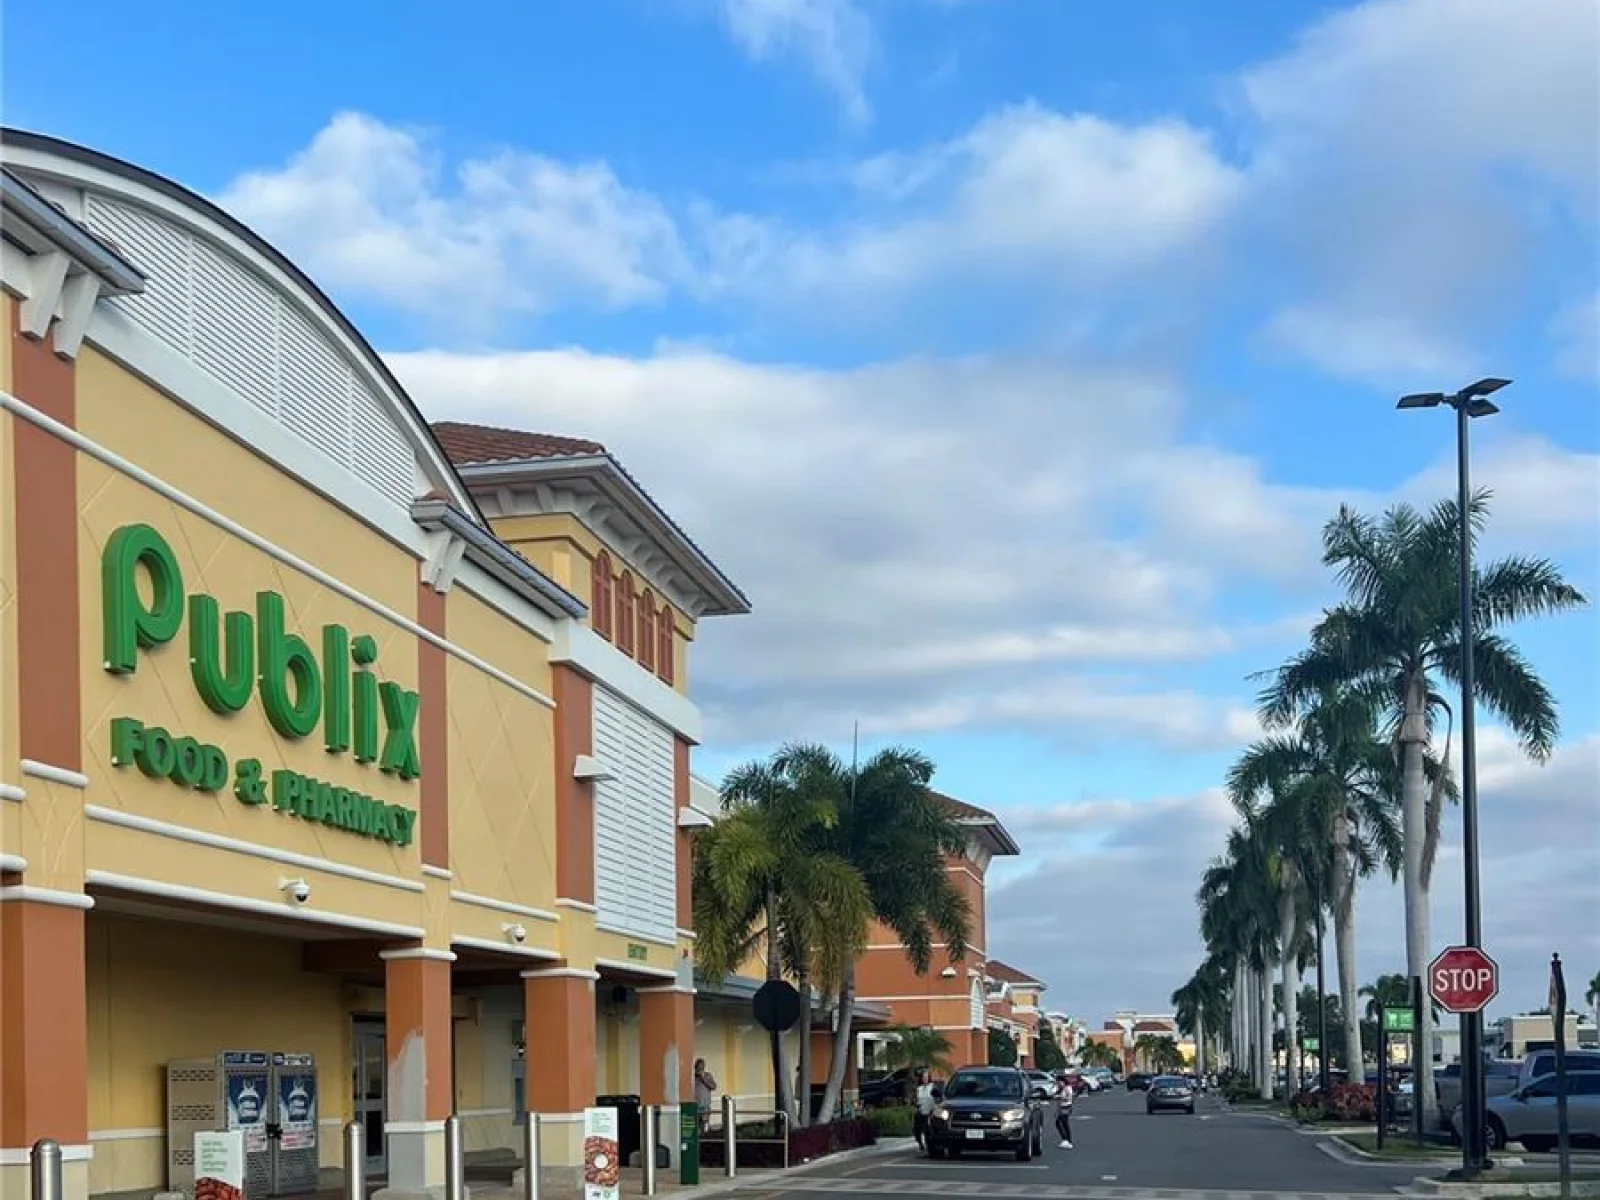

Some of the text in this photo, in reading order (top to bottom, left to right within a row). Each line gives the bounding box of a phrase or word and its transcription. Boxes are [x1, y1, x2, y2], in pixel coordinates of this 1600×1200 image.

[102, 523, 420, 781] Publix
[110, 717, 417, 847] FOOD & PHARMACY
[1435, 968, 1491, 992] STOP
